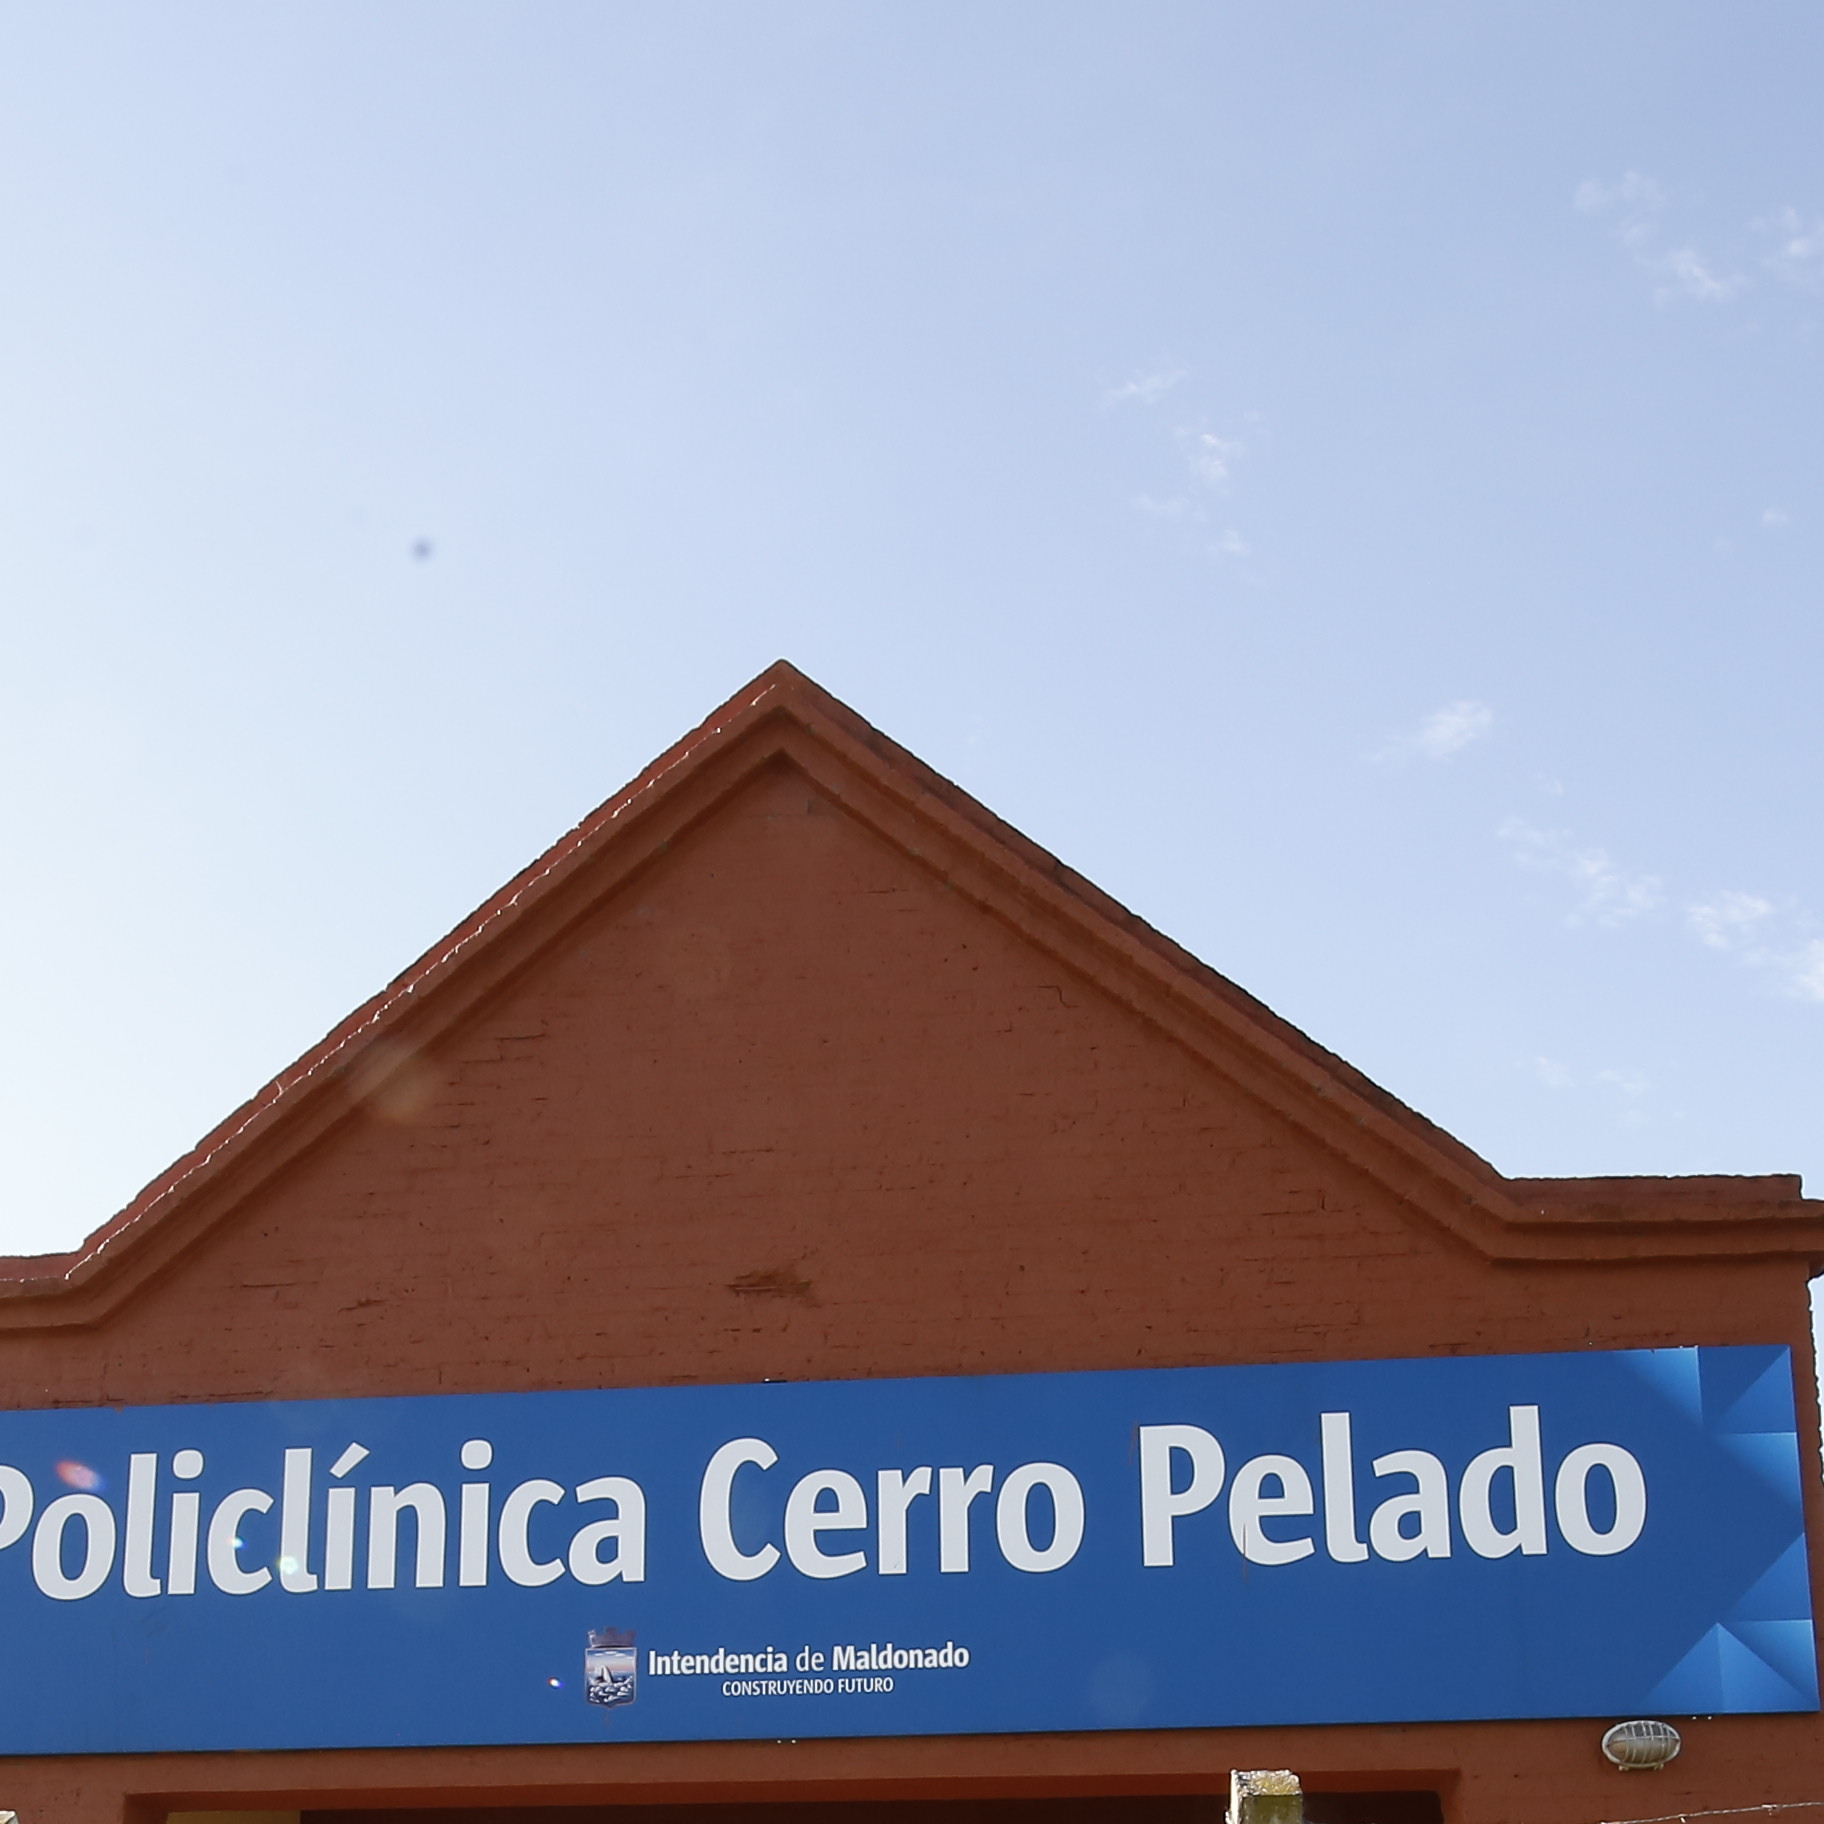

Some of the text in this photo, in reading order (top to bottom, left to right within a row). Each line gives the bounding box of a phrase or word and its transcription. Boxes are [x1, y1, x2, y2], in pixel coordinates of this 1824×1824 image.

[698, 1437, 1086, 1581] Cerro
[1139, 1405, 1646, 1567] Pelado
[648, 1641, 970, 1675] Intendencia de Maldonado
[722, 1676, 894, 1696] CONSTRUYENDO FUTURO
